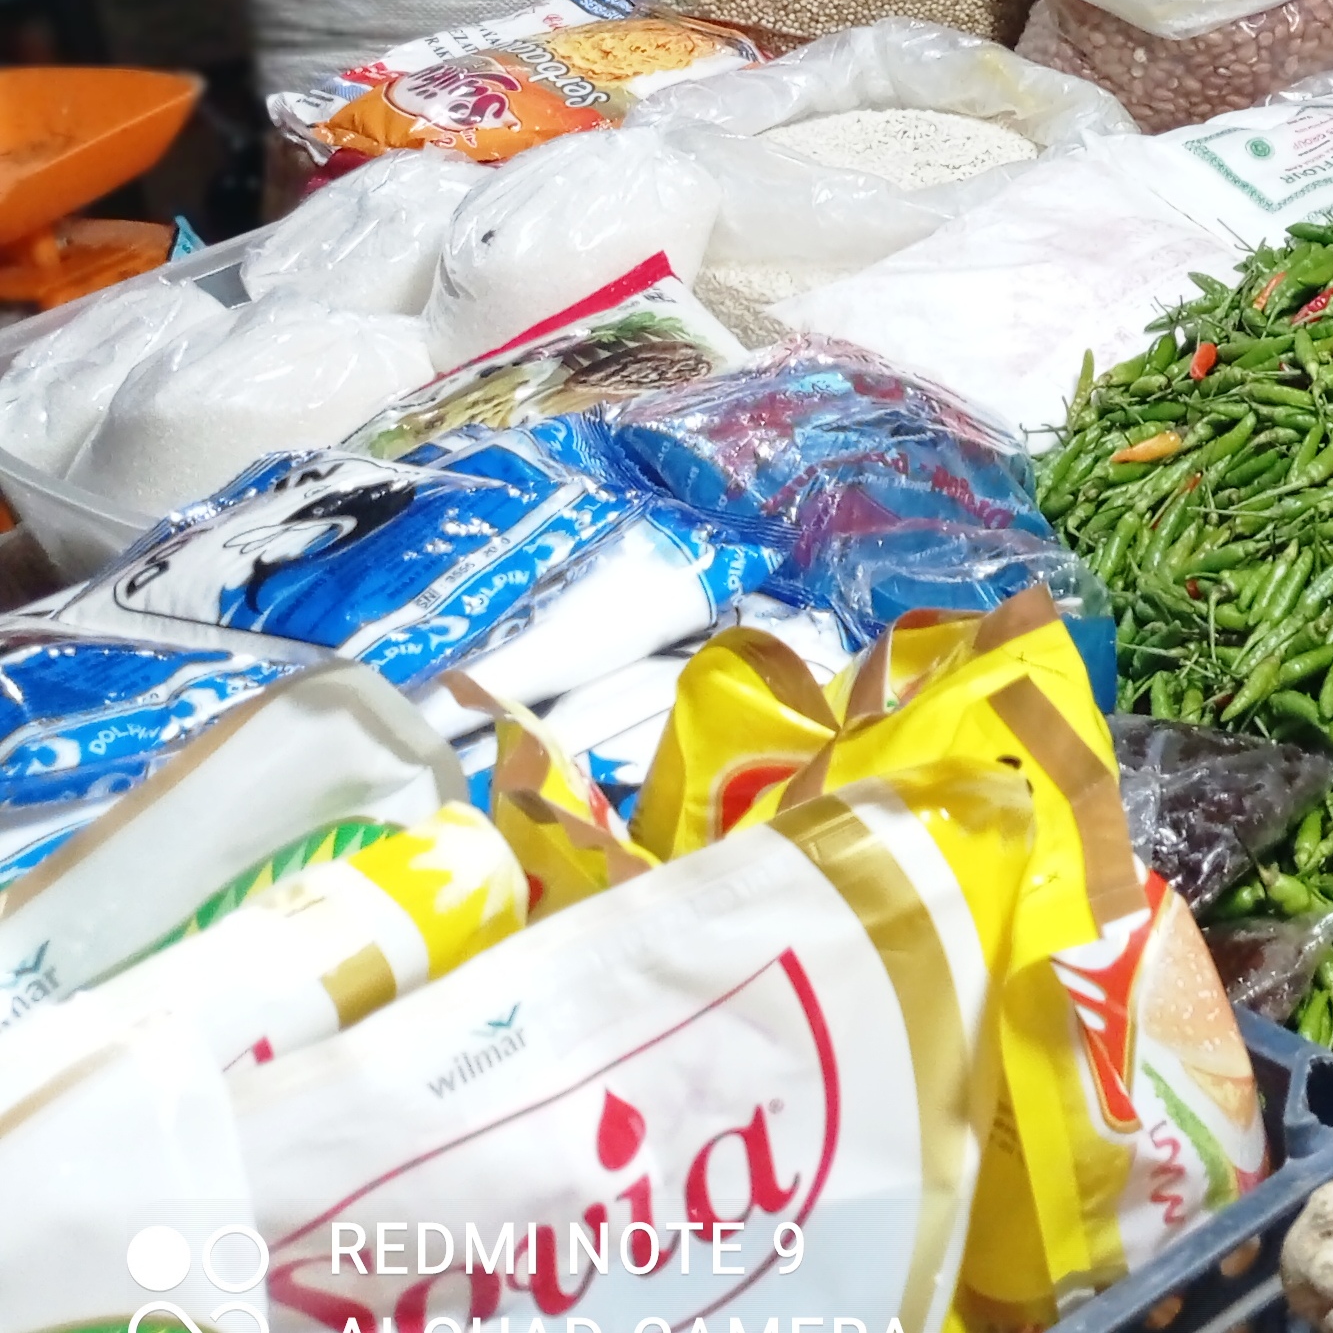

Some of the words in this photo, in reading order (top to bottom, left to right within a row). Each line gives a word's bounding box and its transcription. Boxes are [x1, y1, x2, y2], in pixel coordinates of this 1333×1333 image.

[415, 588, 442, 610] SNI
[425, 1021, 529, 1100] wilmar
[268, 1087, 802, 1333] Sovia
